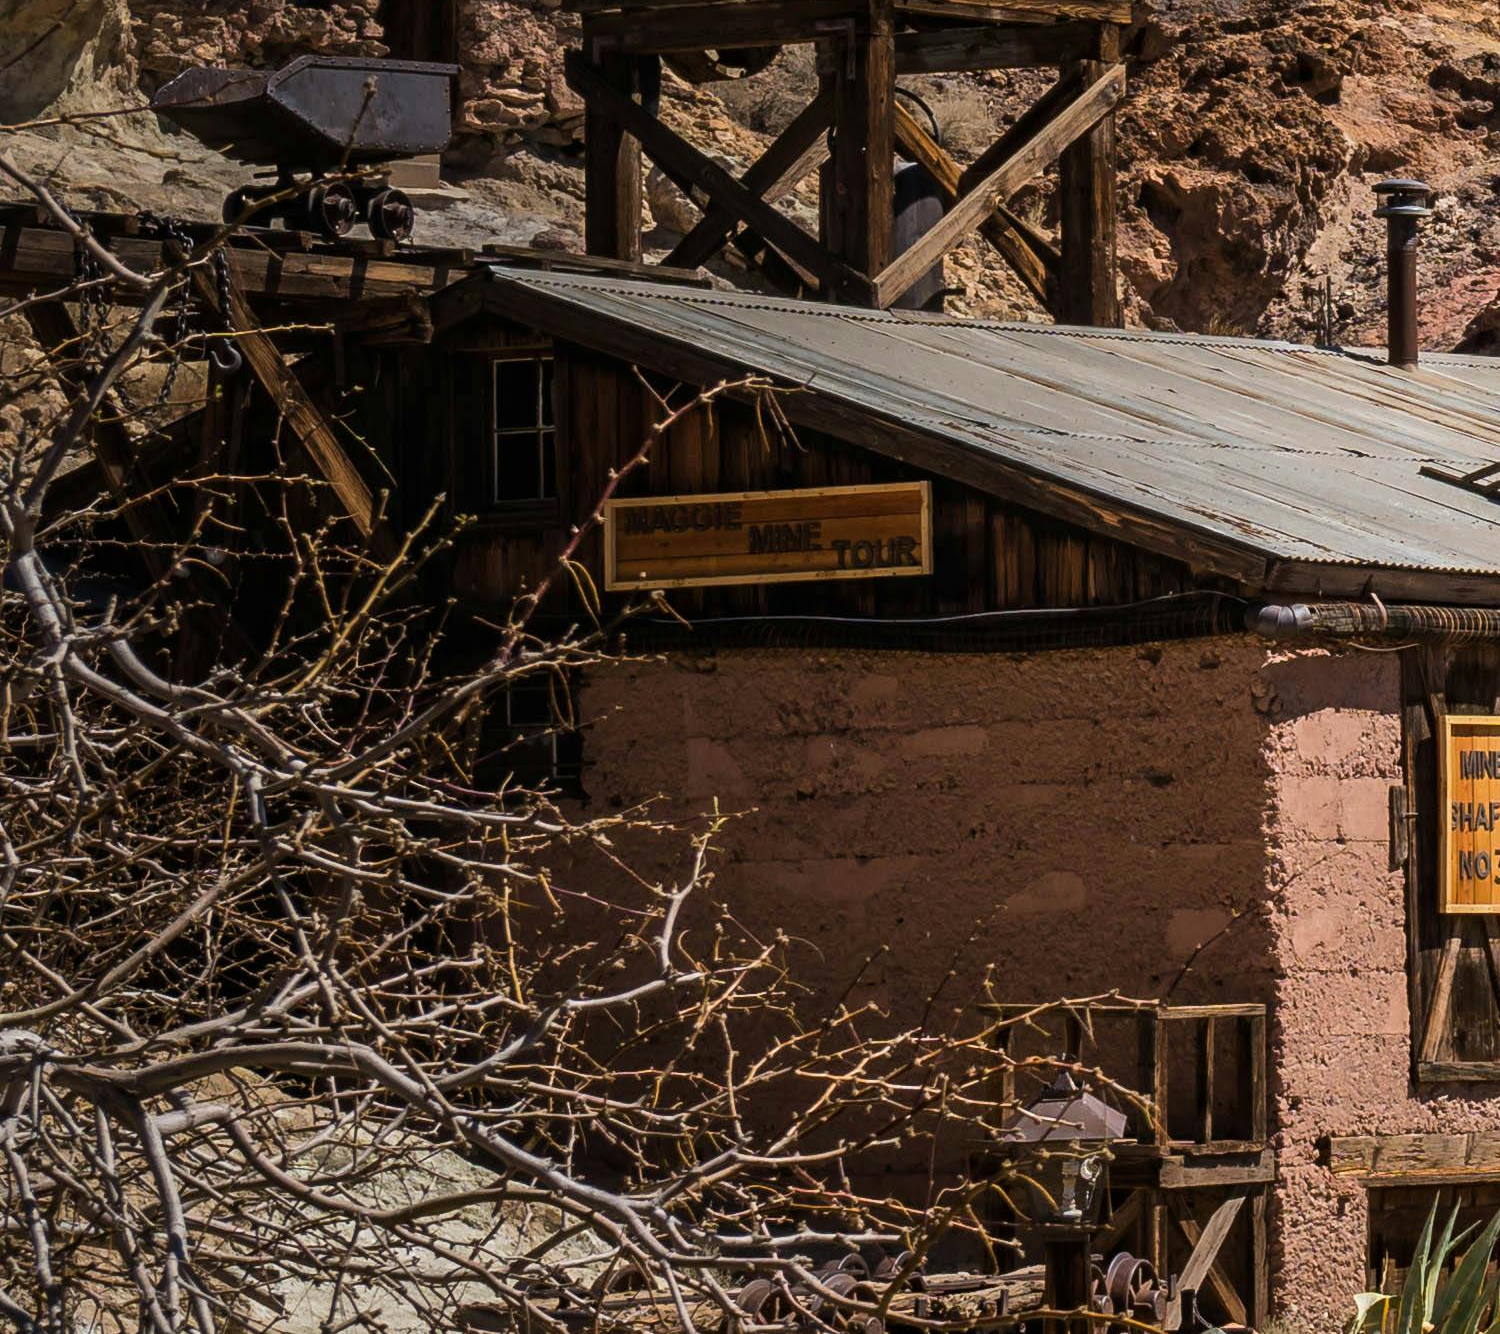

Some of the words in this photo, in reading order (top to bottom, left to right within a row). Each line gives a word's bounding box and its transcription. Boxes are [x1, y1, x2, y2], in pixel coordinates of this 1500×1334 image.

[623, 501, 743, 536] MAGGIE
[748, 521, 823, 554] MINE
[830, 535, 918, 567] TOUR
[1459, 850, 1491, 880] NO
